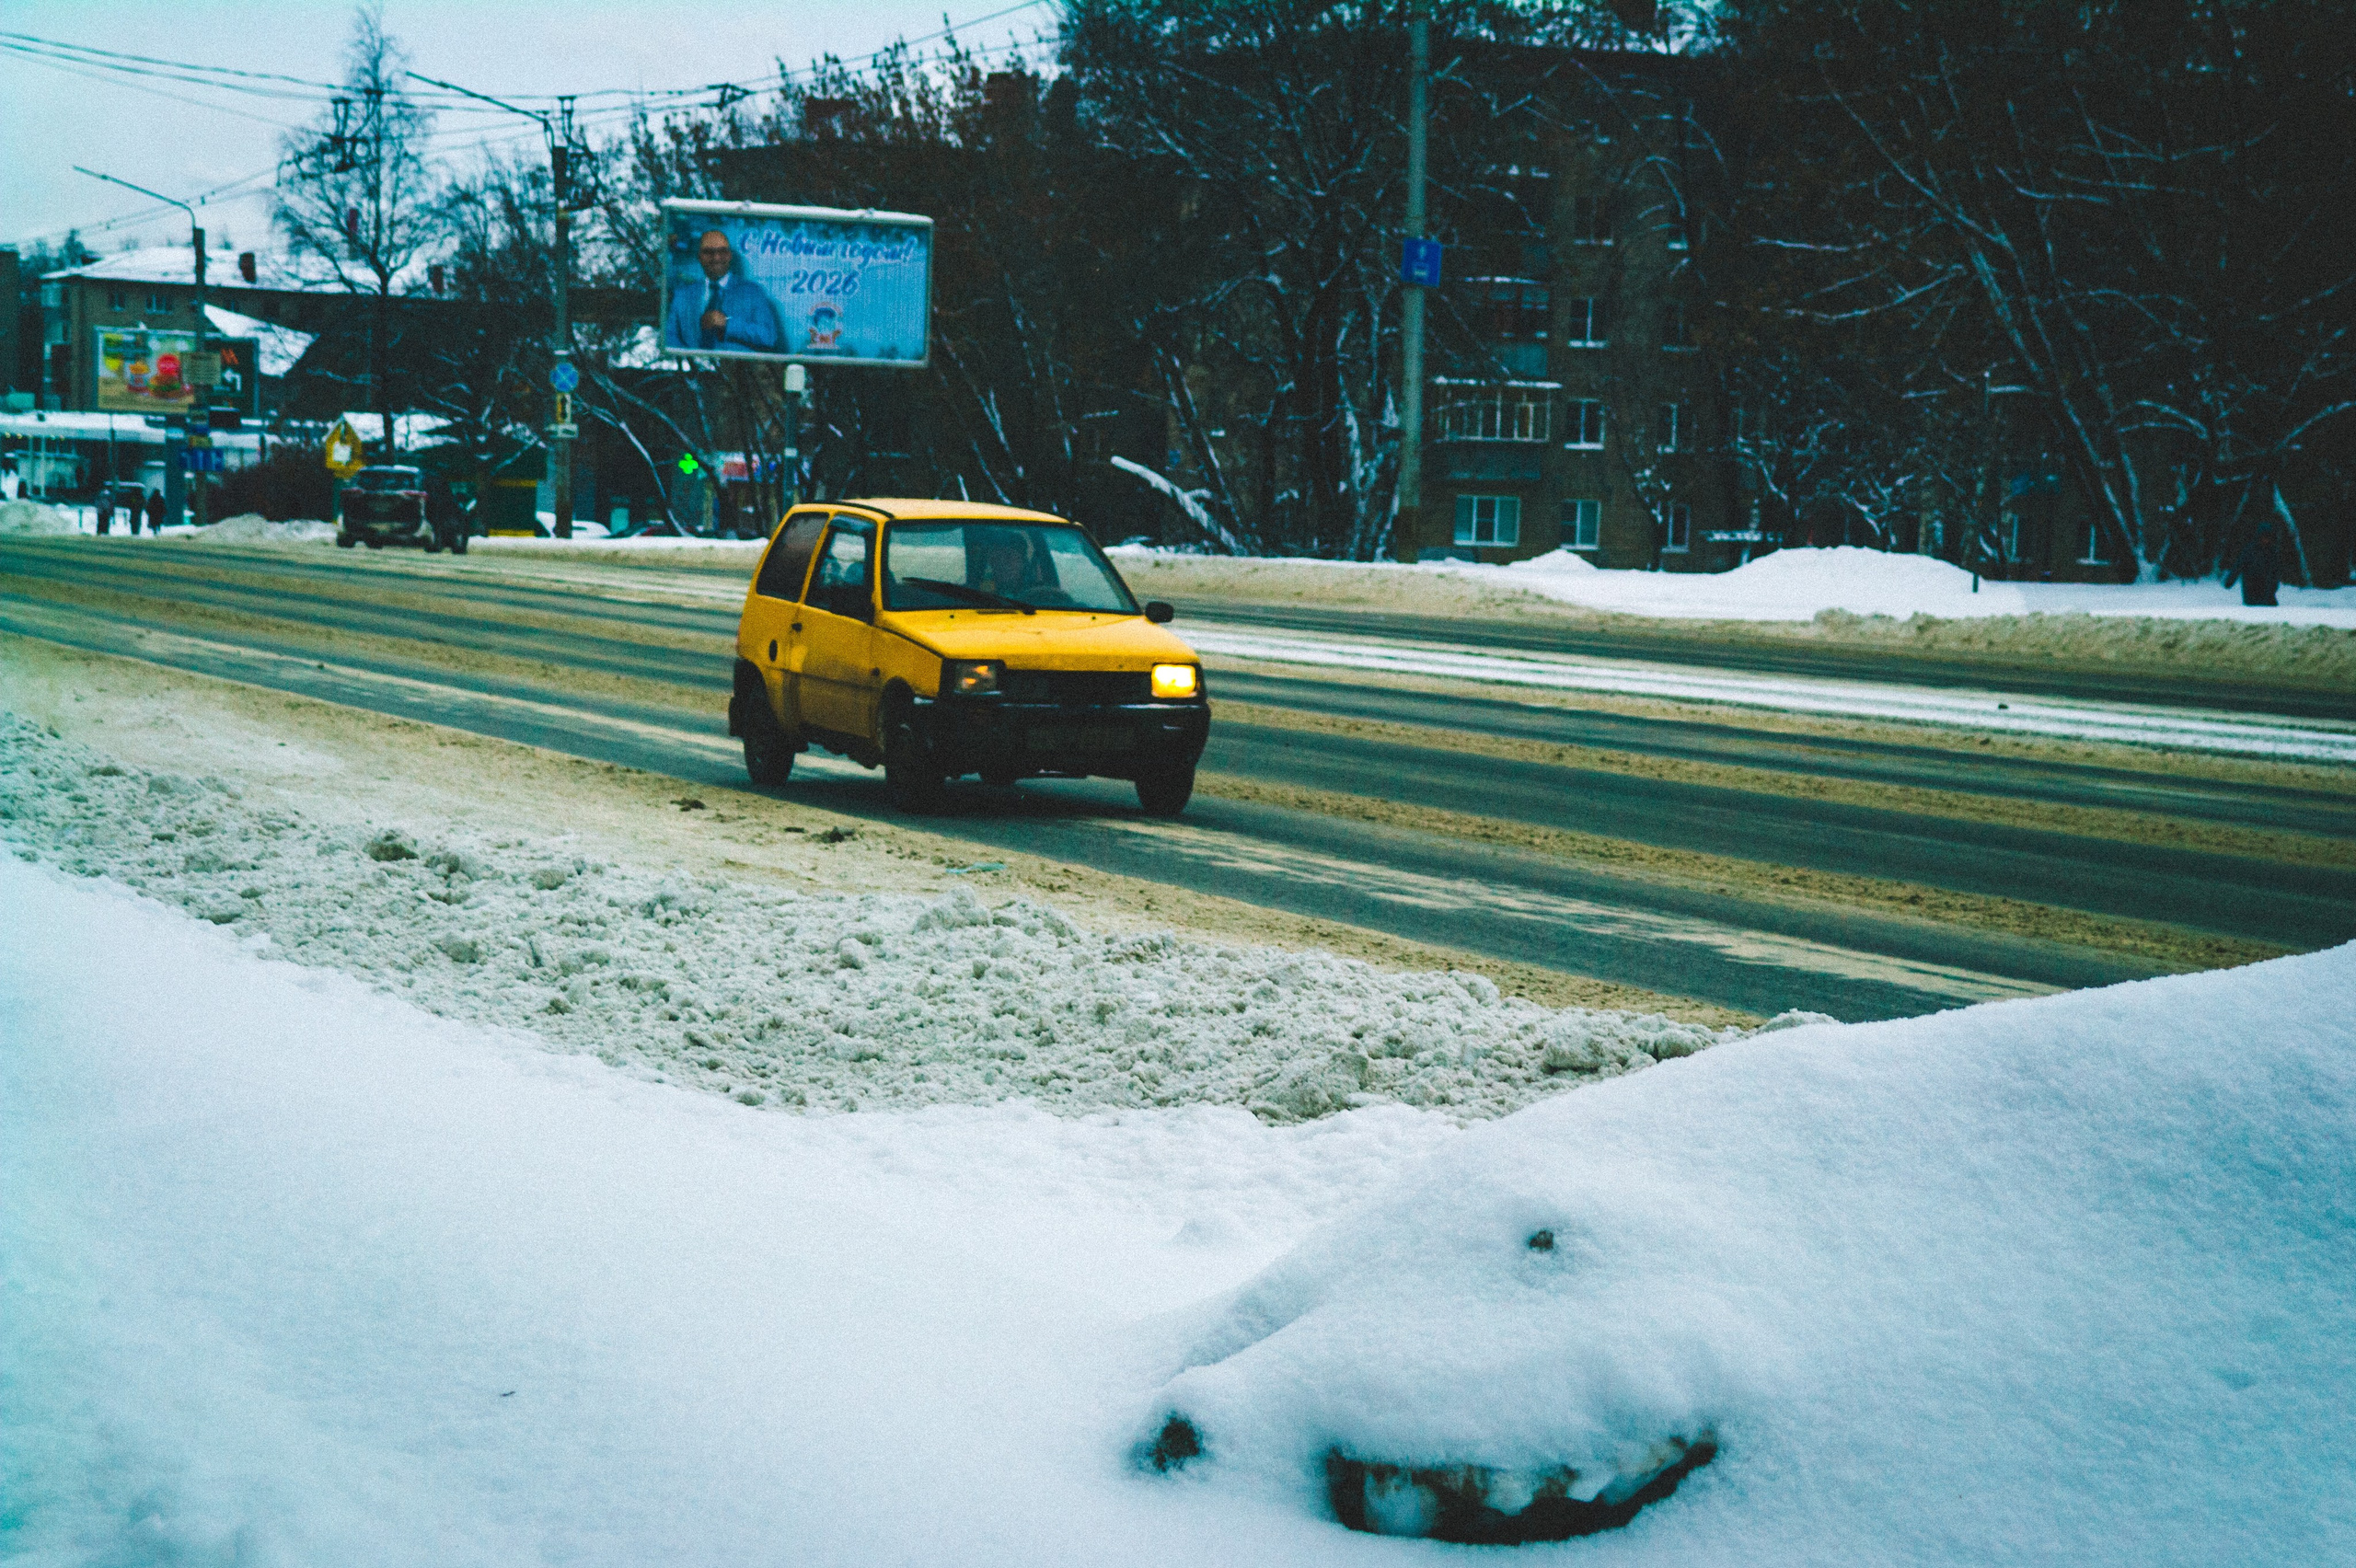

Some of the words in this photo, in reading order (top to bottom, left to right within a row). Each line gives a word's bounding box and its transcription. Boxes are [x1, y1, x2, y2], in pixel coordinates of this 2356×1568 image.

[740, 231, 756, 255] С
[760, 230, 837, 257] Новым
[791, 269, 860, 295] 2026
